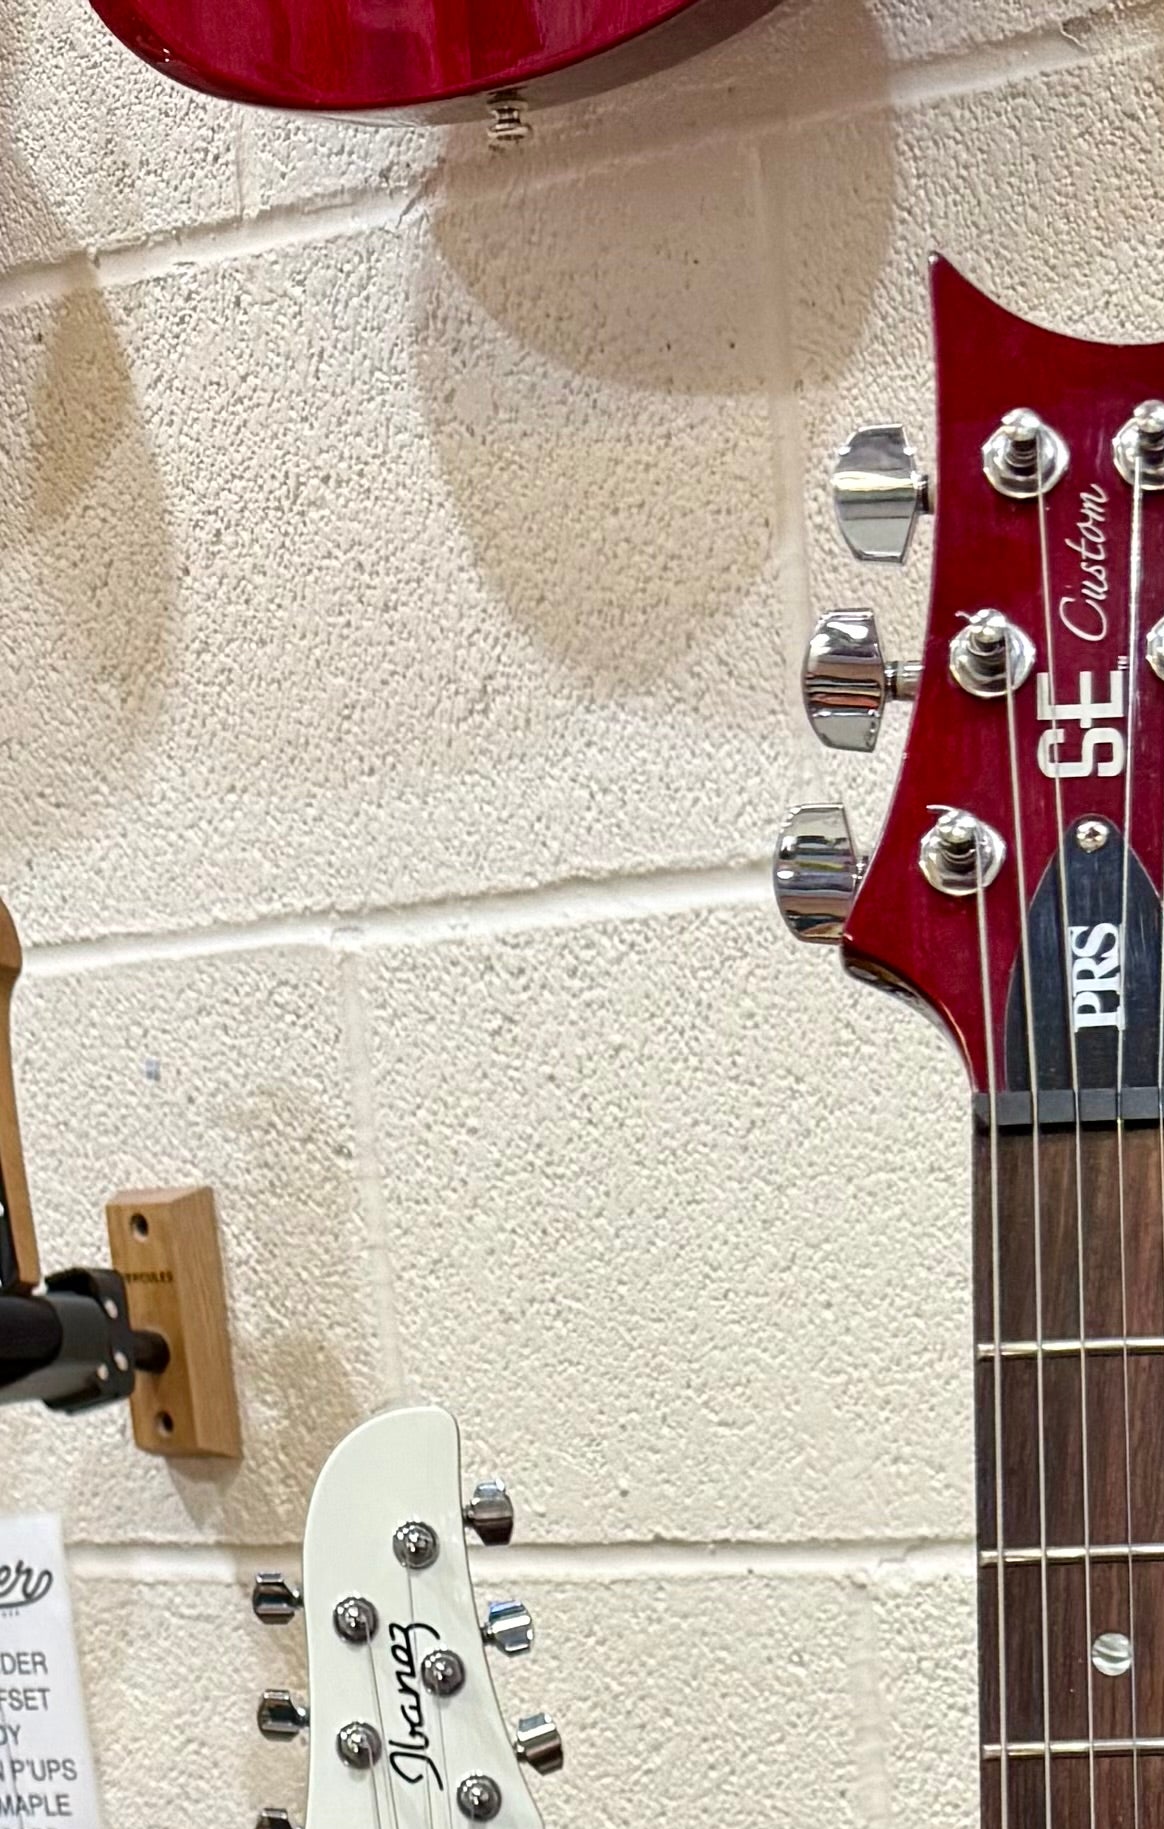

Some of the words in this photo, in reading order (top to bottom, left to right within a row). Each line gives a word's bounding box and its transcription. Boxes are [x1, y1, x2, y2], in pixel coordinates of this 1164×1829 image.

[1059, 483, 1110, 642] Custom
[1036, 669, 1125, 779] SE
[1068, 922, 1126, 1034] PRS
[388, 1622, 444, 1792] Ibanez
[0, 1793, 73, 1817] MAPLE
